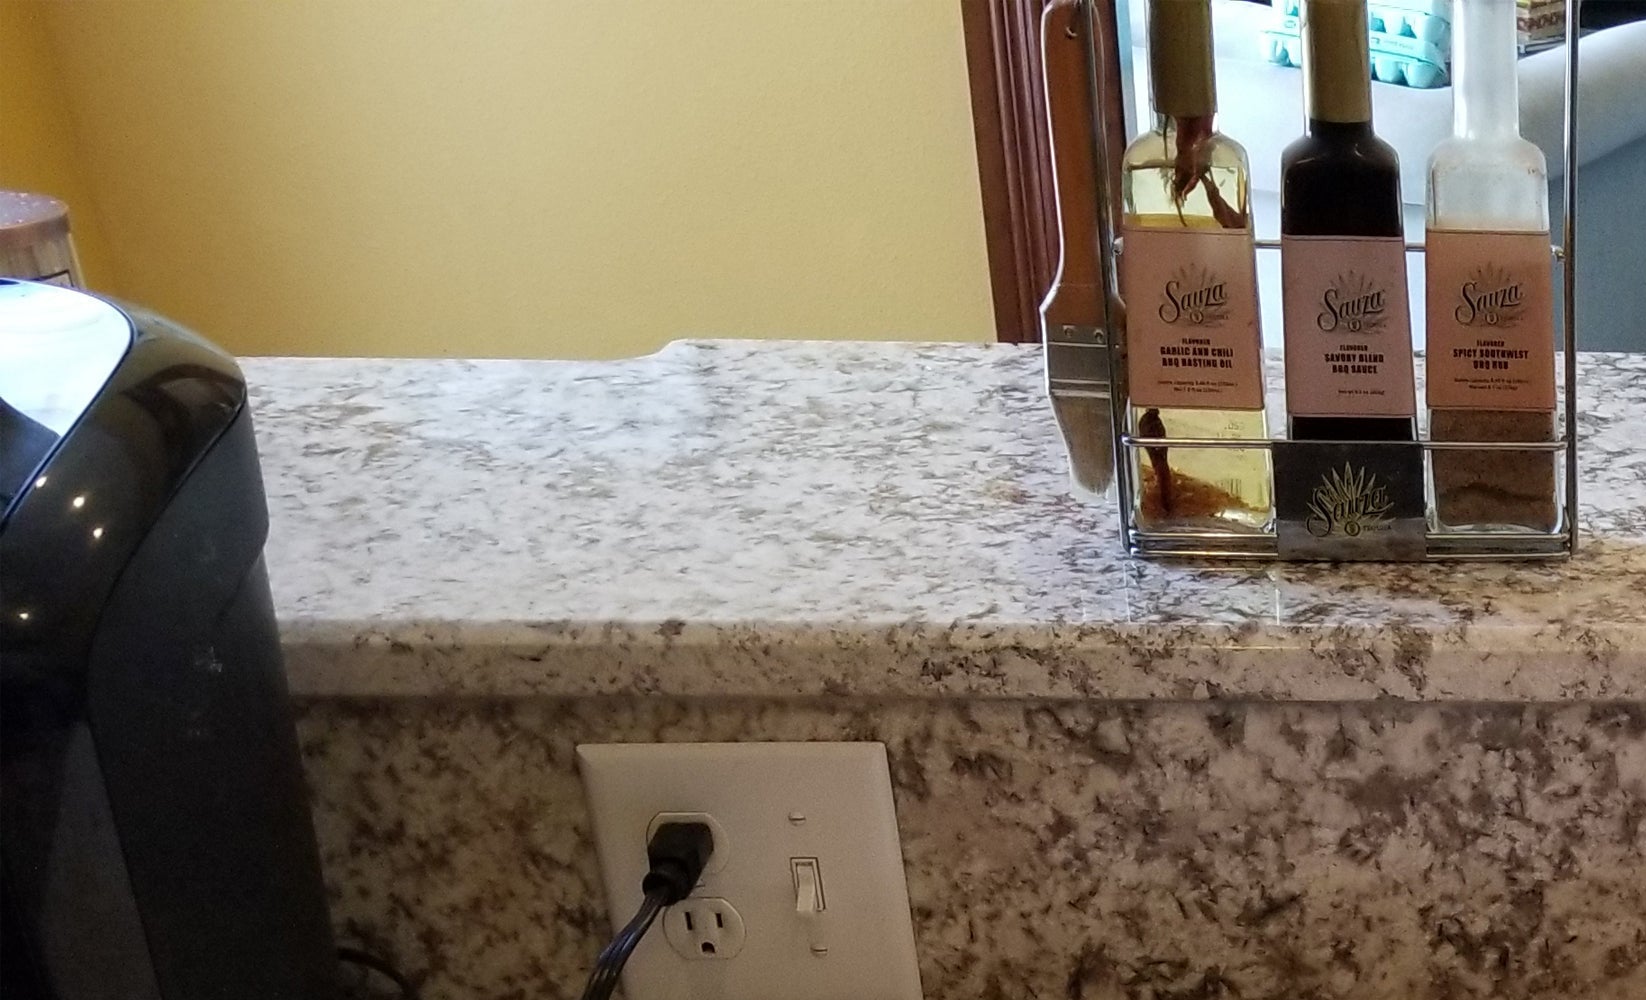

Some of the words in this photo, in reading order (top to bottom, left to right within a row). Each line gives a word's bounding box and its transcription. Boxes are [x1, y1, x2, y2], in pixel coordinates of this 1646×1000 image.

[1159, 280, 1227, 324] Sauza
[1455, 282, 1525, 326] Sauza
[1317, 288, 1386, 332] Sauza
[1160, 346, 1191, 356] GARLIC
[1192, 347, 1209, 356] AND
[1211, 348, 1234, 358] CHILI
[1453, 348, 1477, 358] SPICY
[1479, 349, 1529, 359] SOUTHWEST
[1162, 358, 1179, 367] BBQ
[1181, 358, 1218, 368] BASTING
[1219, 359, 1233, 368] OIL
[1324, 353, 1356, 363] SAVORY
[1358, 354, 1384, 363] BLEND
[1332, 364, 1349, 374] BBQ
[1351, 365, 1378, 374] SAUCE
[1473, 360, 1490, 370] BBQ
[1492, 361, 1509, 370] RUB
[1306, 486, 1390, 537] Sauza
